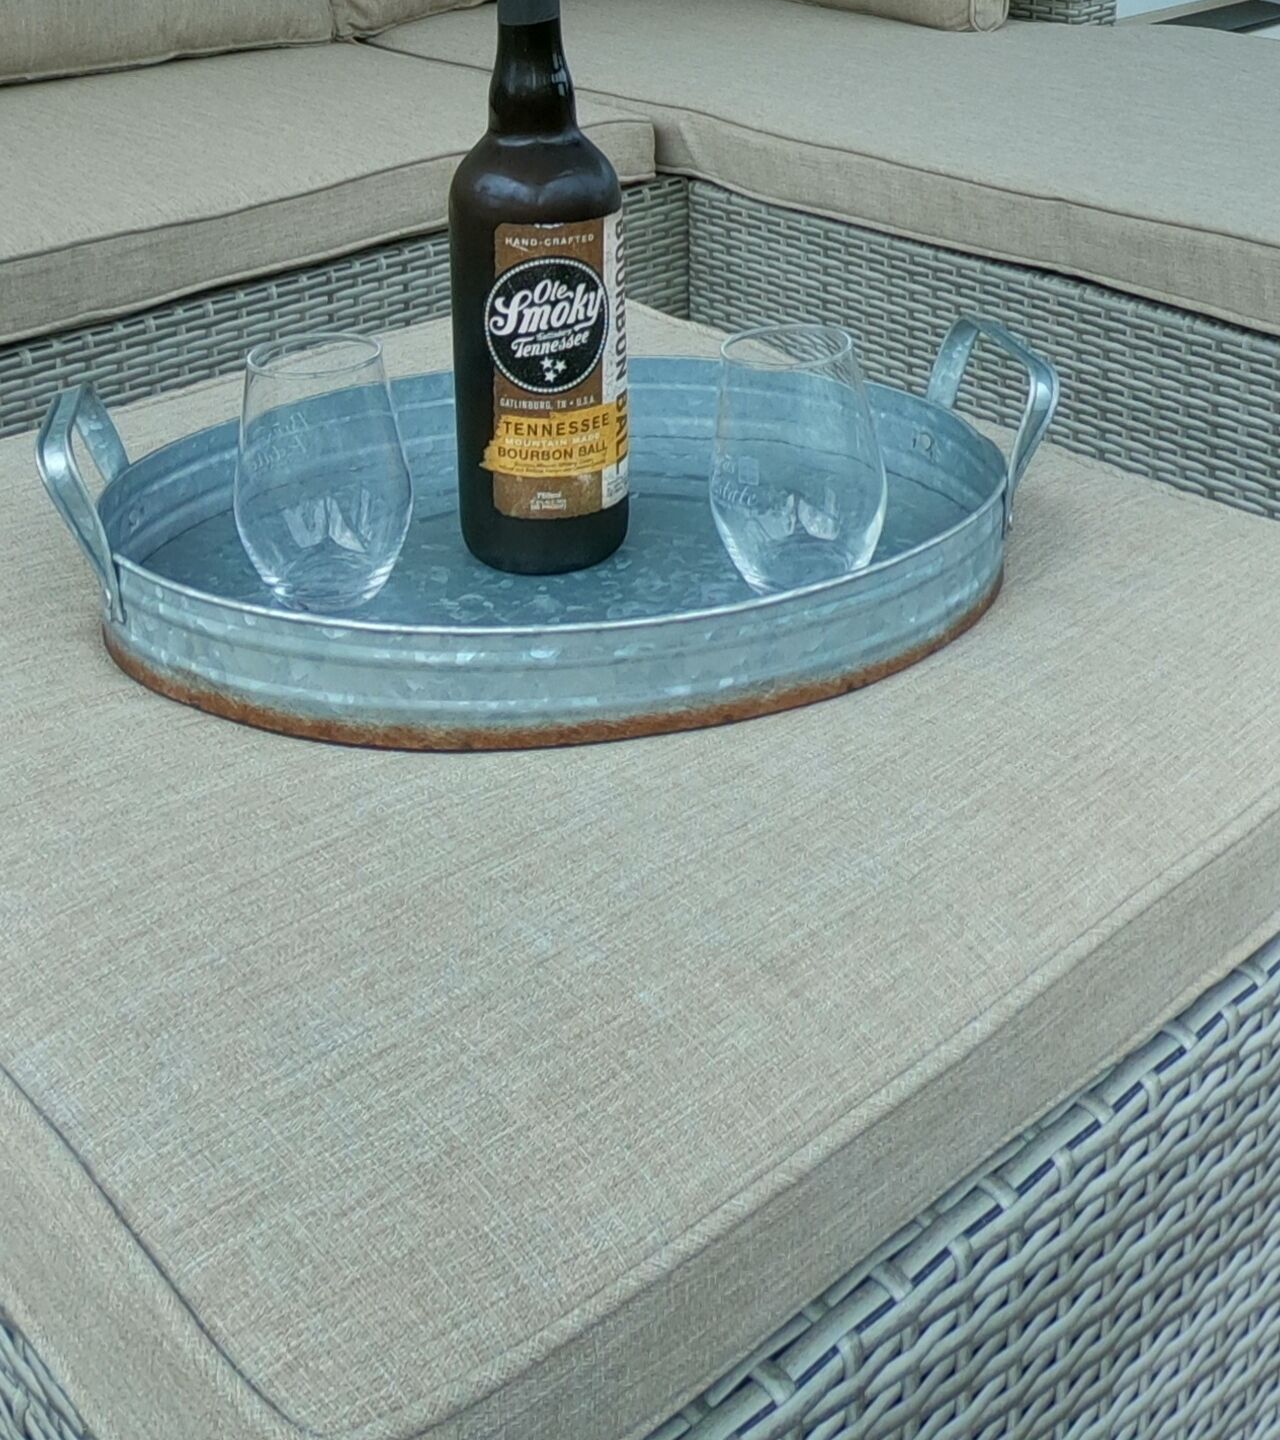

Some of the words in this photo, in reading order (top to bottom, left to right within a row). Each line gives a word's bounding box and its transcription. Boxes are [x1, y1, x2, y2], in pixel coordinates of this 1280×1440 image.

[504, 233, 594, 247] HAND-CRAFTED
[533, 279, 574, 304] Ole
[489, 283, 603, 336] Smoky
[510, 330, 590, 358] Tennessee
[502, 412, 610, 437] TENNESSEE
[497, 446, 573, 461] BOURBON
[577, 440, 607, 457] BALL
[504, 436, 567, 448] MOUNTAIN
[571, 432, 600, 444] MADE
